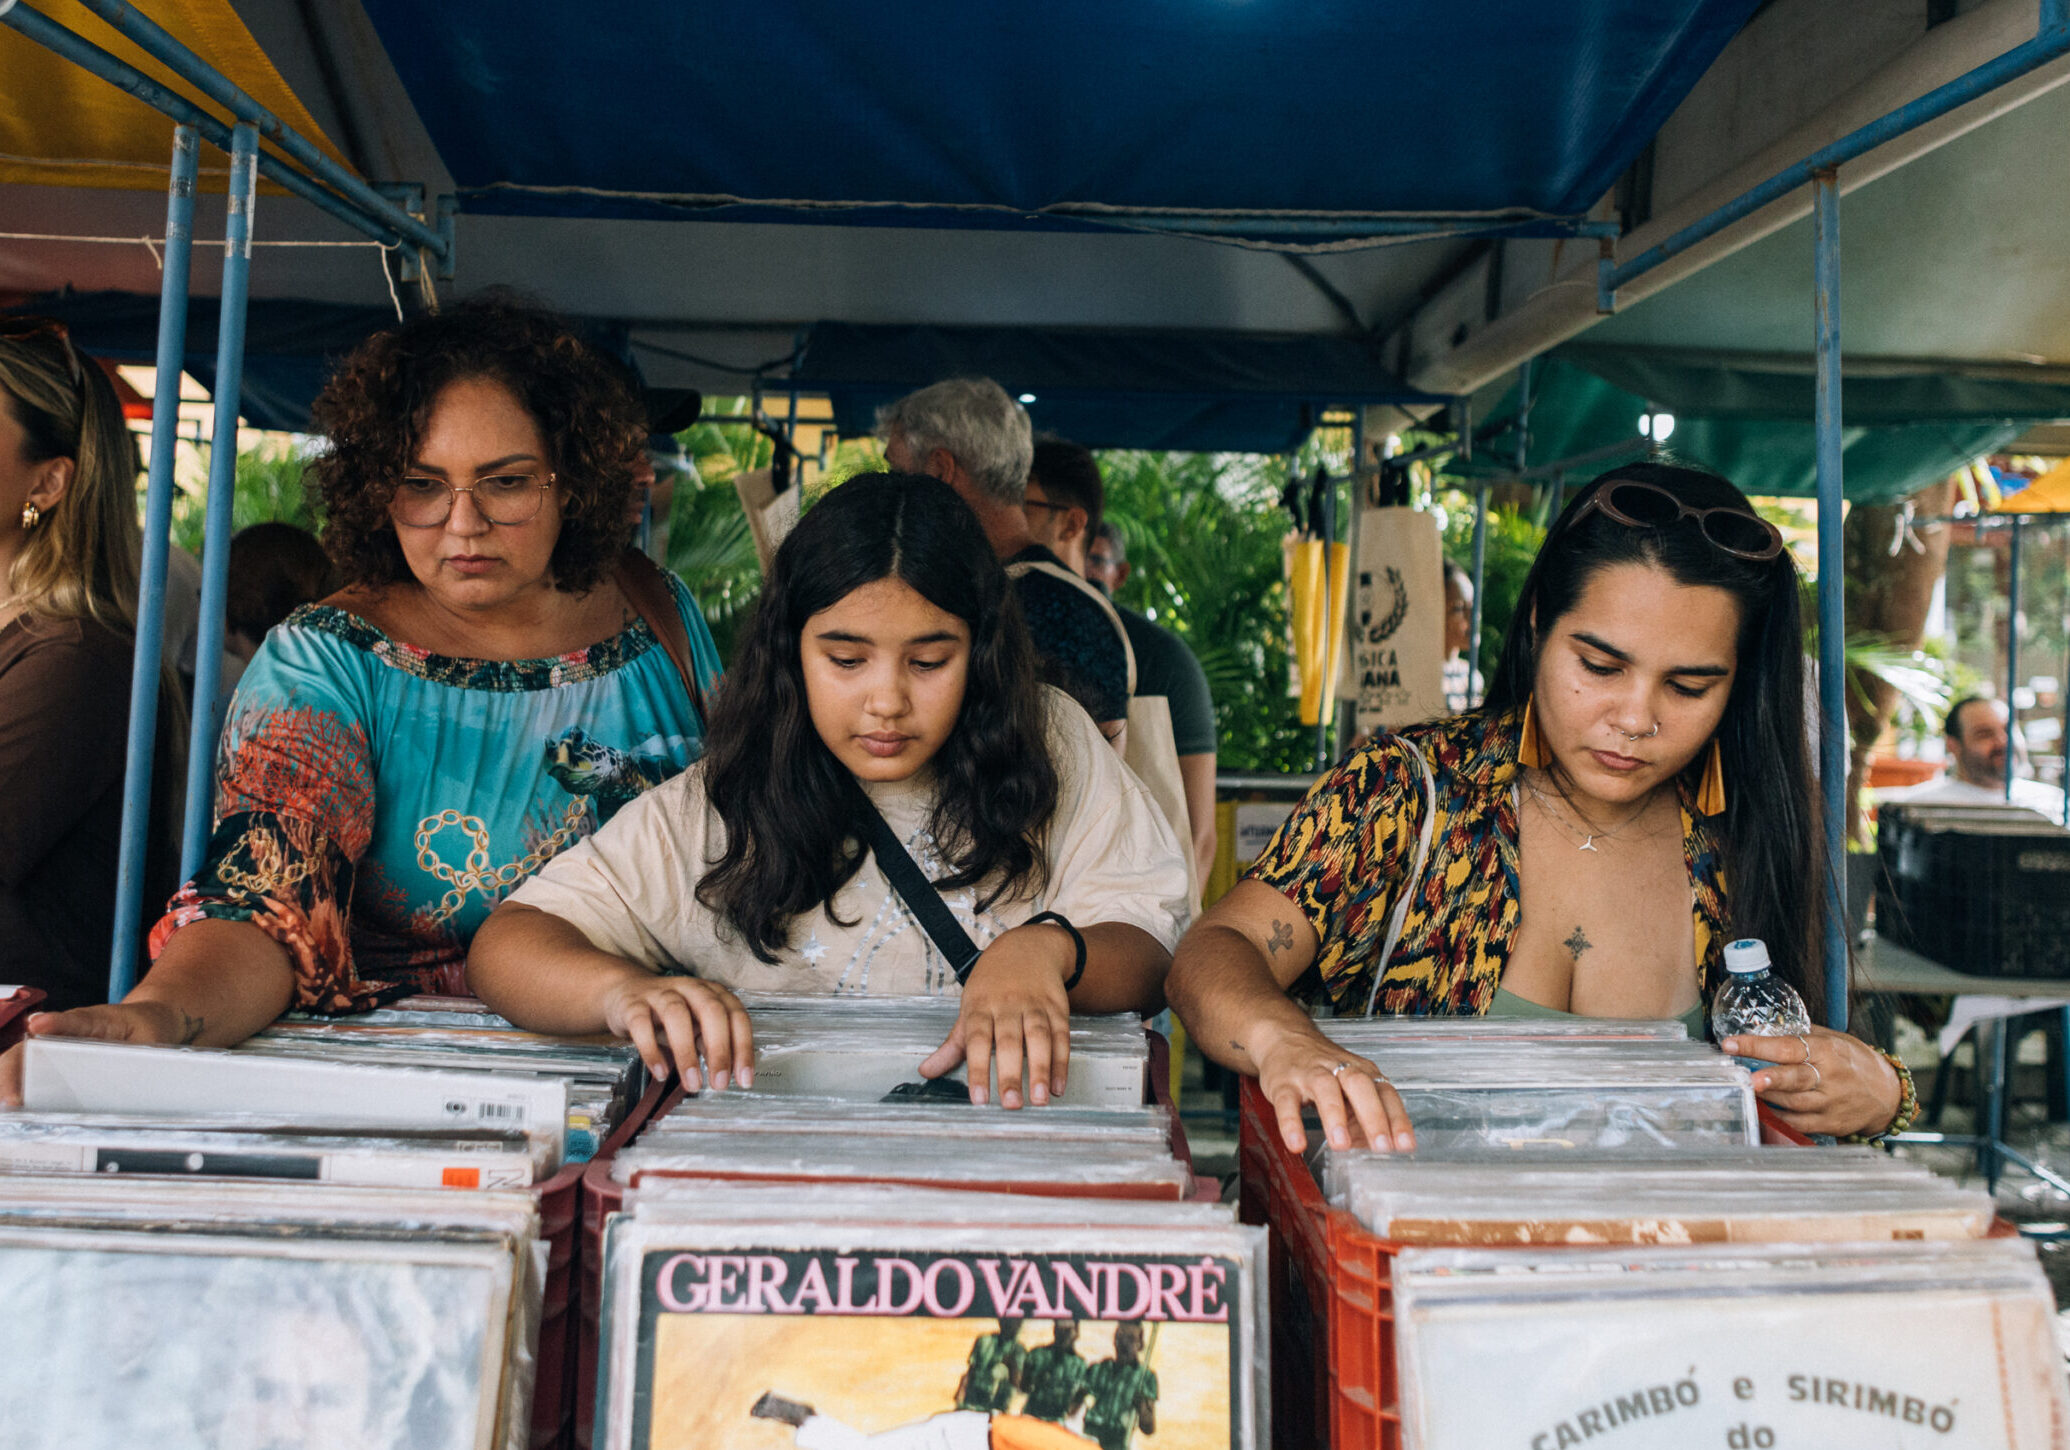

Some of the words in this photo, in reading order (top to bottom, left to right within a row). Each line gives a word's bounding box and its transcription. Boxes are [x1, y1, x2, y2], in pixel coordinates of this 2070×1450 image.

[655, 1253, 975, 1316] GERALDO
[1531, 1364, 1700, 1450] CARIMBÓ
[1733, 1375, 1755, 1400] e
[1787, 1373, 1961, 1433] SIRIMBÓ
[1726, 1421, 1775, 1450] do
